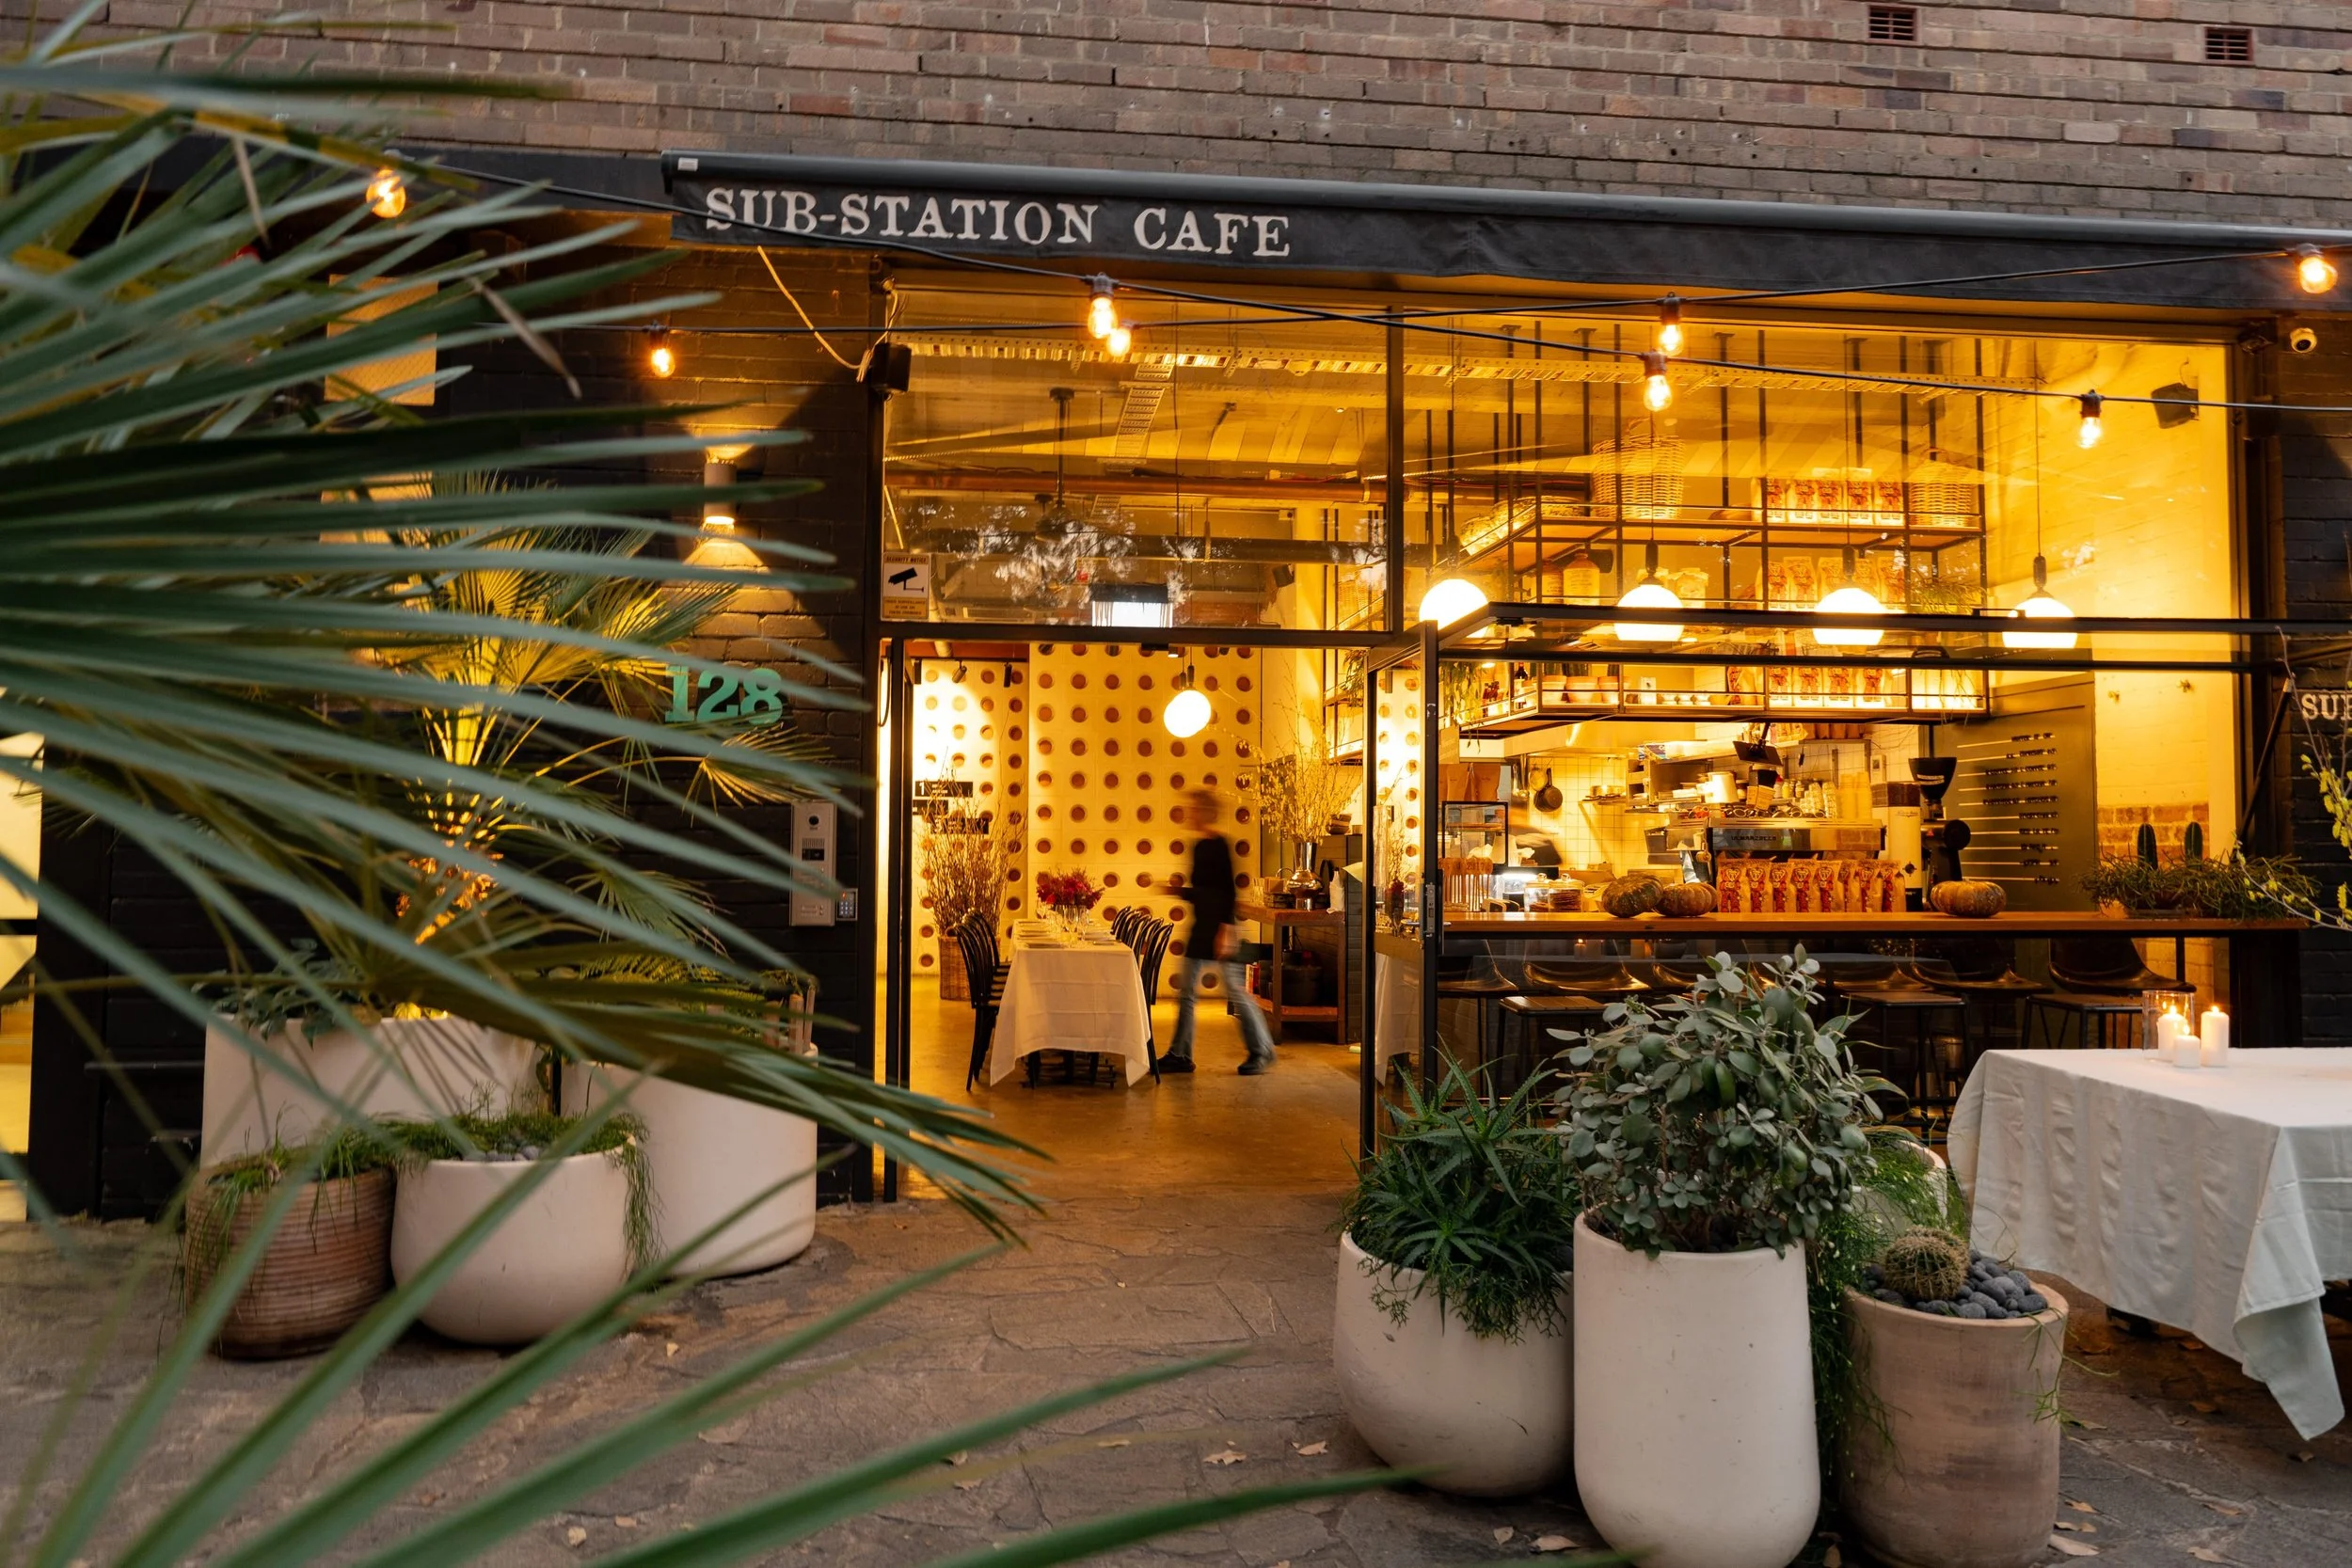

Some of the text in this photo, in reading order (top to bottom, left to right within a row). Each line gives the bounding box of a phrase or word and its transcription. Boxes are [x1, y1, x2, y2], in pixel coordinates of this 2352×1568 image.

[706, 186, 1291, 257] SUB-STATION CAFE
[664, 664, 784, 725] 128
[918, 782, 925, 796] 1
